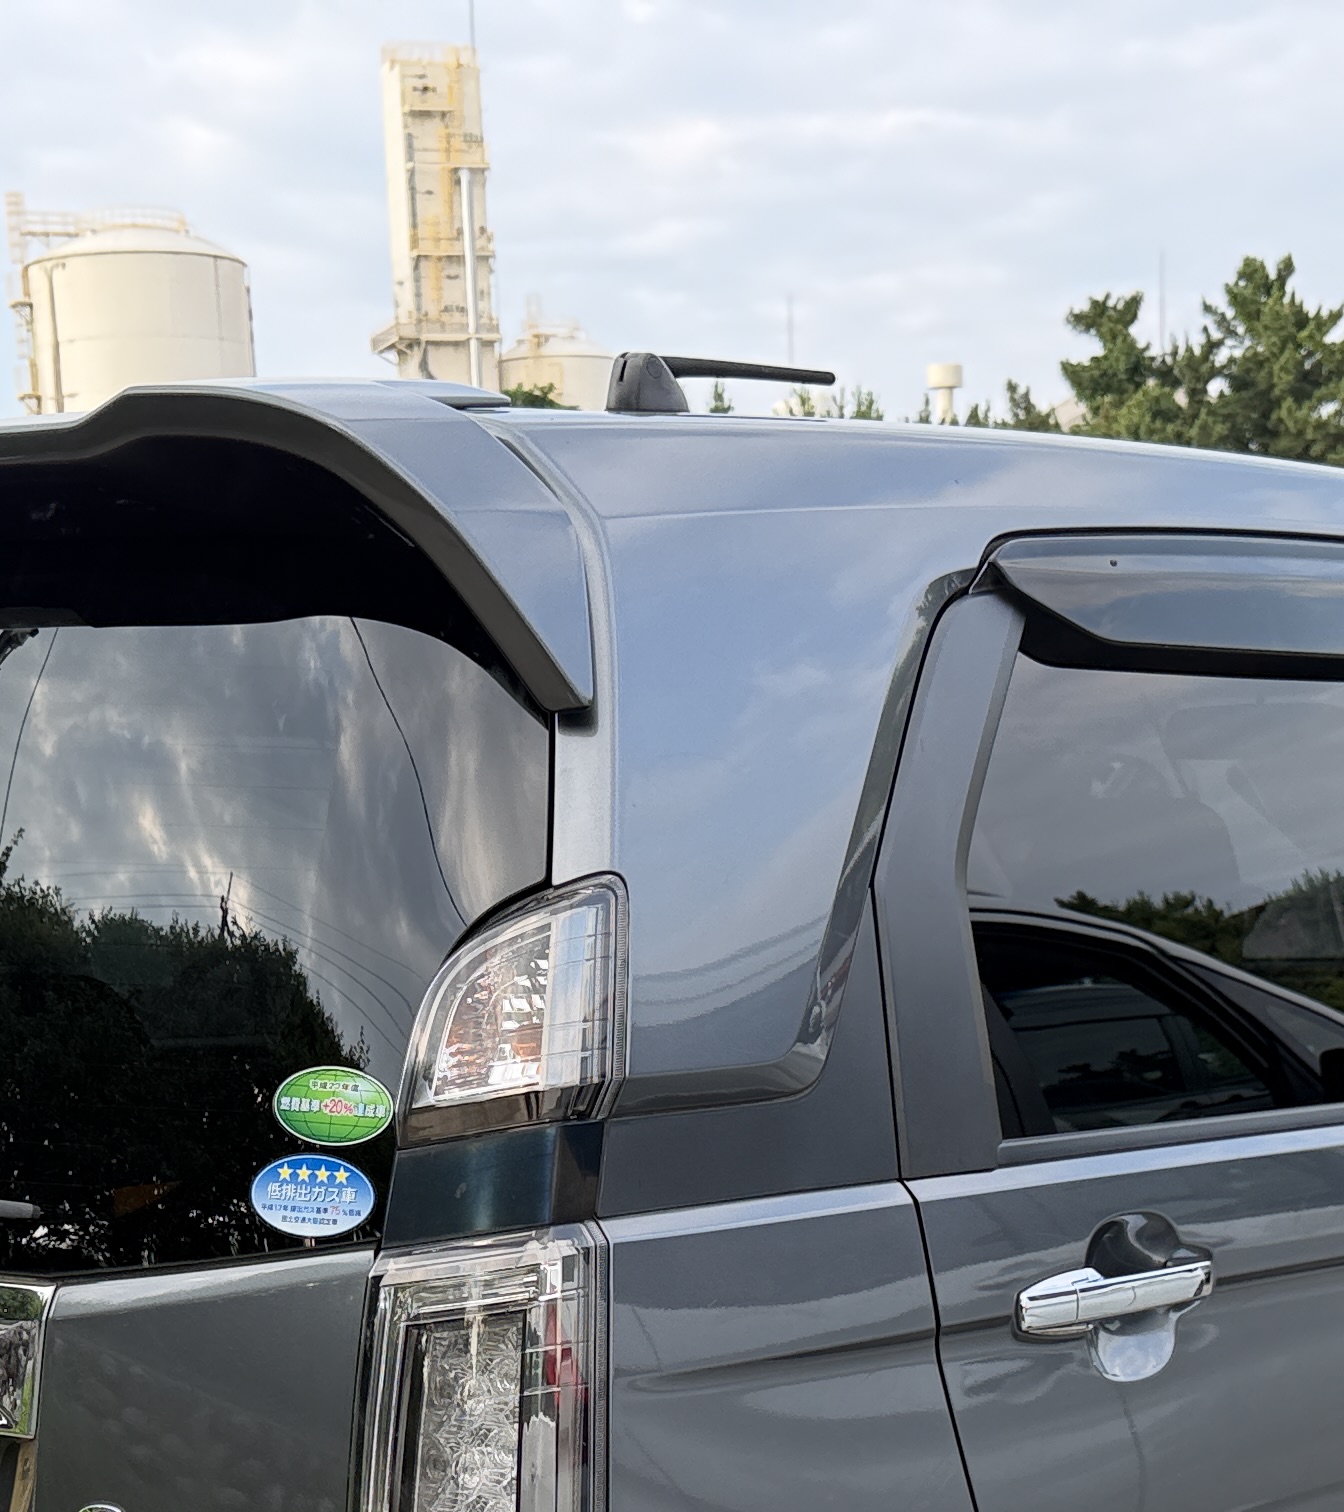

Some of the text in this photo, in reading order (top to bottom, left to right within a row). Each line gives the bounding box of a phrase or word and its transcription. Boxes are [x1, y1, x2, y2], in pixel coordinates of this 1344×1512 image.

[267, 1182, 358, 1204] 低排出ガス車
